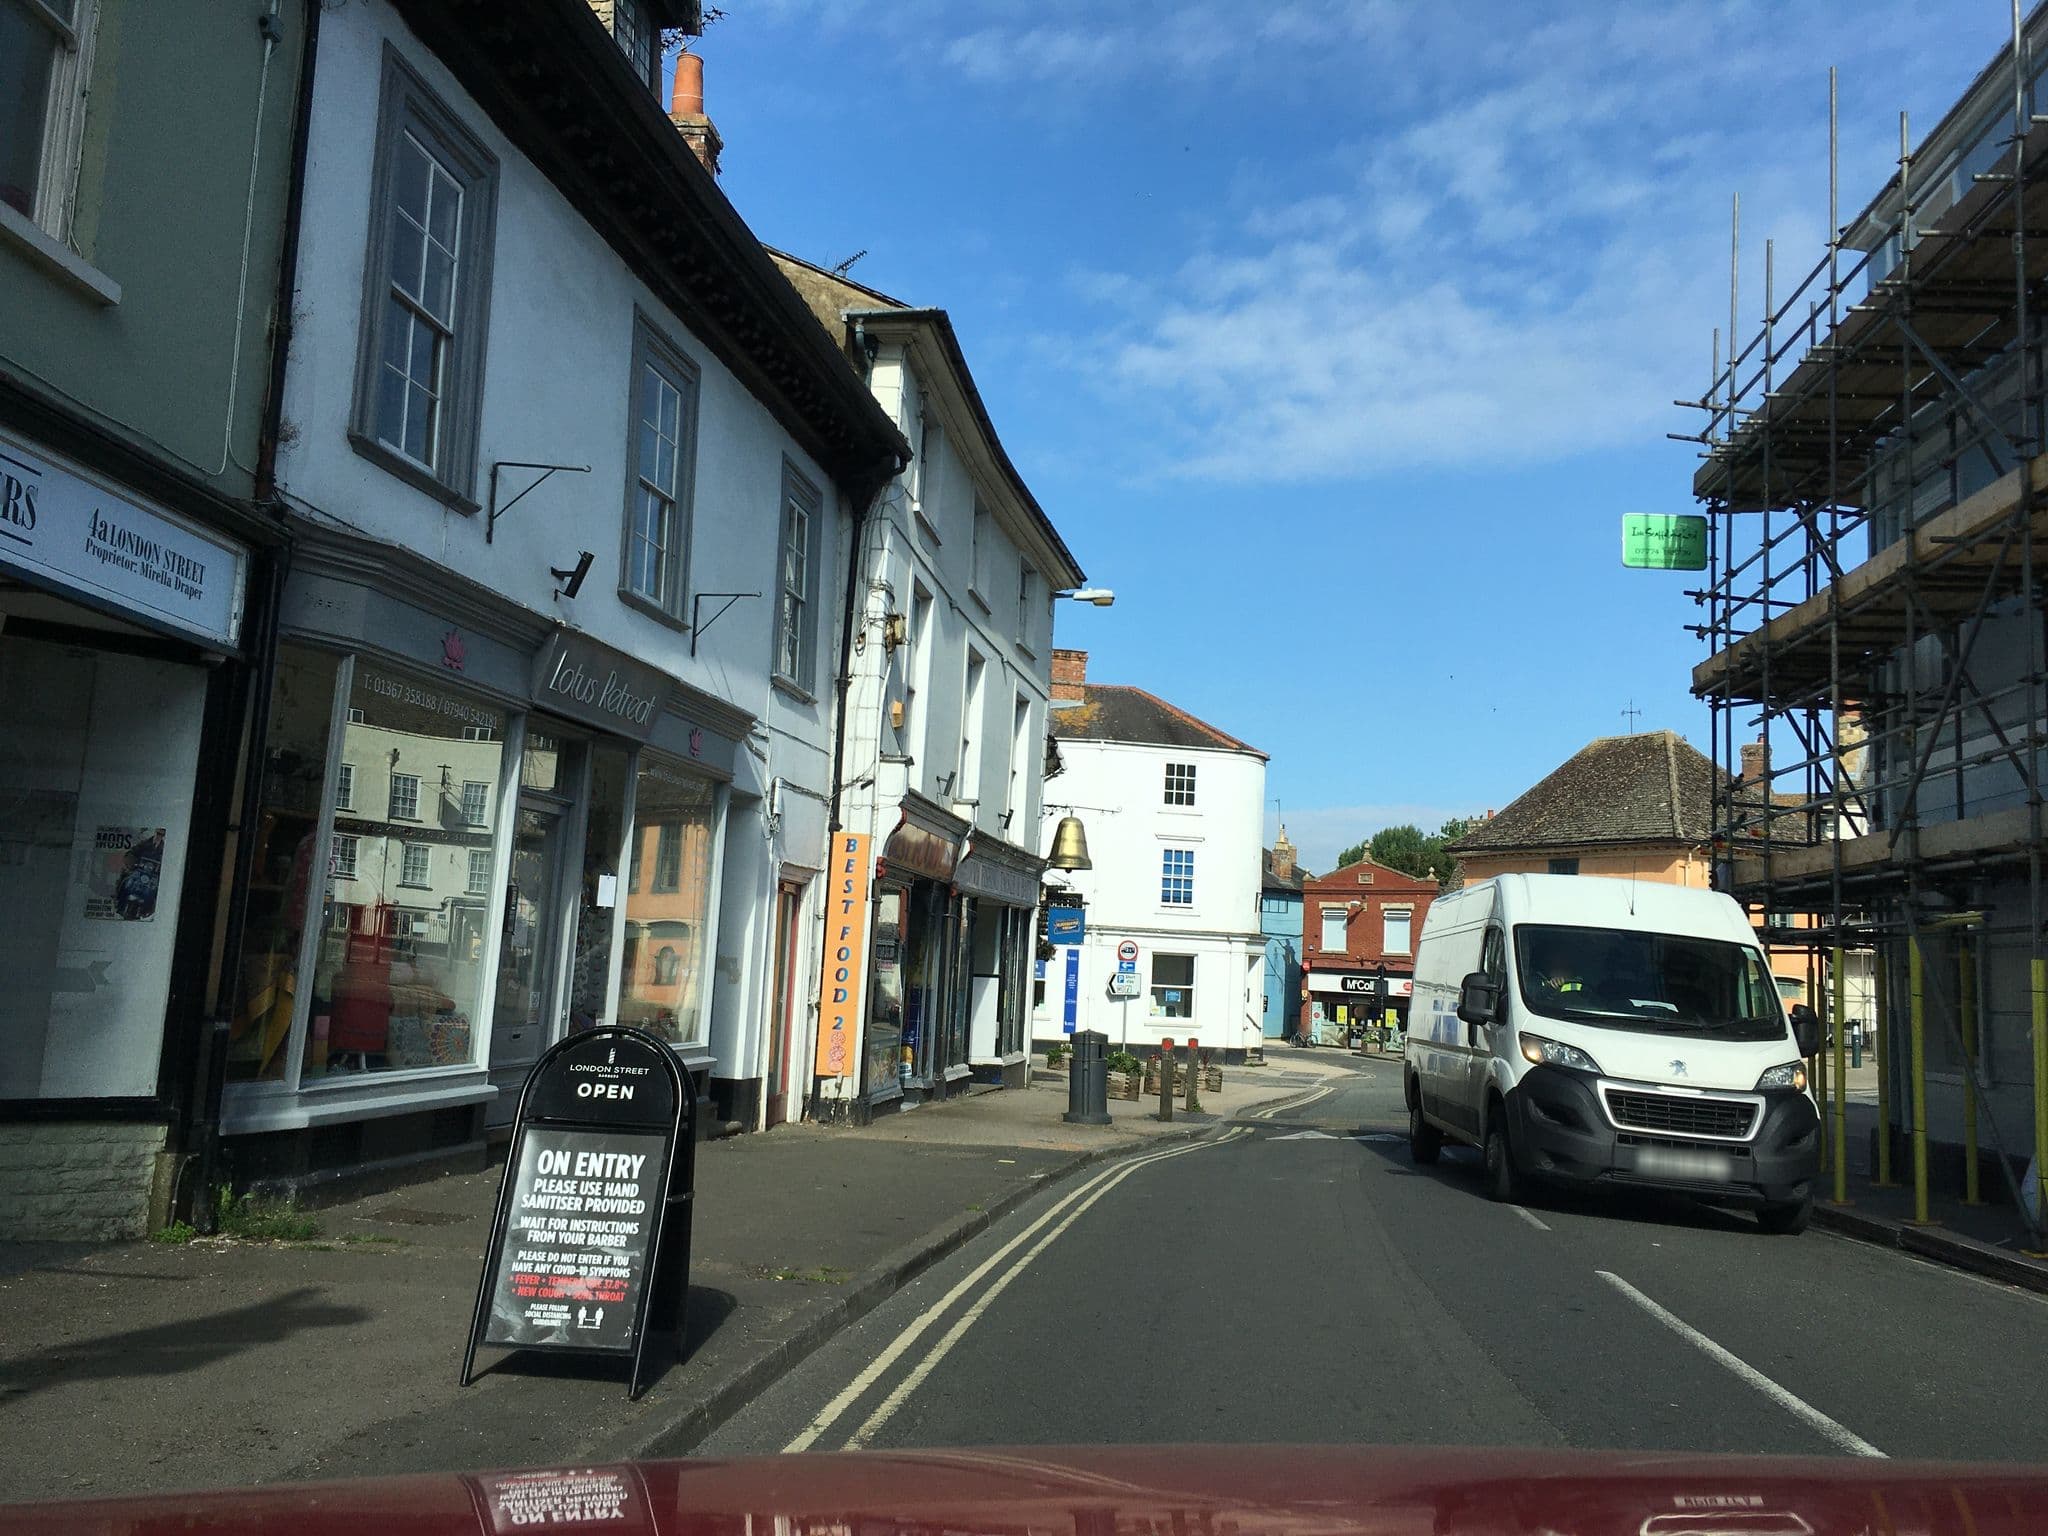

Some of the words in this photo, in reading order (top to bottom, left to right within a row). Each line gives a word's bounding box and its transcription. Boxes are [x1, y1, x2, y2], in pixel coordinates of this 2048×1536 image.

[0, 472, 38, 530] RS
[88, 508, 108, 542] 4a
[110, 524, 161, 565] LONDON
[163, 548, 206, 585] STREET
[85, 537, 137, 573] Proprietor:
[140, 561, 171, 588] Mirella
[174, 576, 203, 600] Draper
[374, 677, 403, 699] 01367
[405, 687, 437, 710] 358188
[549, 649, 598, 704] Lotus
[598, 670, 656, 725] Retreat
[96, 832, 132, 849] MODS
[1346, 979, 1375, 991] McColl
[570, 1064, 611, 1073] LONDON
[613, 1066, 650, 1075] STREET
[577, 1083, 634, 1100] OPEN
[537, 1149, 571, 1175] ON
[574, 1152, 646, 1179] ENTRY
[533, 1178, 577, 1194] PLEASE
[579, 1181, 603, 1196] USE
[604, 1182, 639, 1198] HAND
[520, 1194, 583, 1212] SANITISER
[584, 1198, 646, 1215] PROVIDED
[520, 1215, 547, 1230] WAIT
[548, 1217, 568, 1231] FOR
[569, 1219, 640, 1235] INSTRUCTIONS
[527, 1229, 556, 1243] FROM
[558, 1231, 586, 1245] YOUR
[587, 1234, 627, 1247] BARBER
[518, 1250, 547, 1262] PLEASE
[548, 1252, 560, 1263] DO
[560, 1253, 577, 1264] NOT
[578, 1254, 602, 1265] ENTER
[603, 1255, 612, 1266] IF
[612, 1255, 630, 1266] YOU
[511, 1262, 533, 1273] HAVE
[534, 1263, 551, 1274] ANY
[552, 1264, 589, 1276] COVID-19
[589, 1266, 631, 1278] SYMPTOMS
[515, 1274, 540, 1285] FEVER
[517, 1286, 537, 1297] NEW
[594, 1291, 626, 1302] THROAT
[530, 1303, 549, 1311] PLEASE
